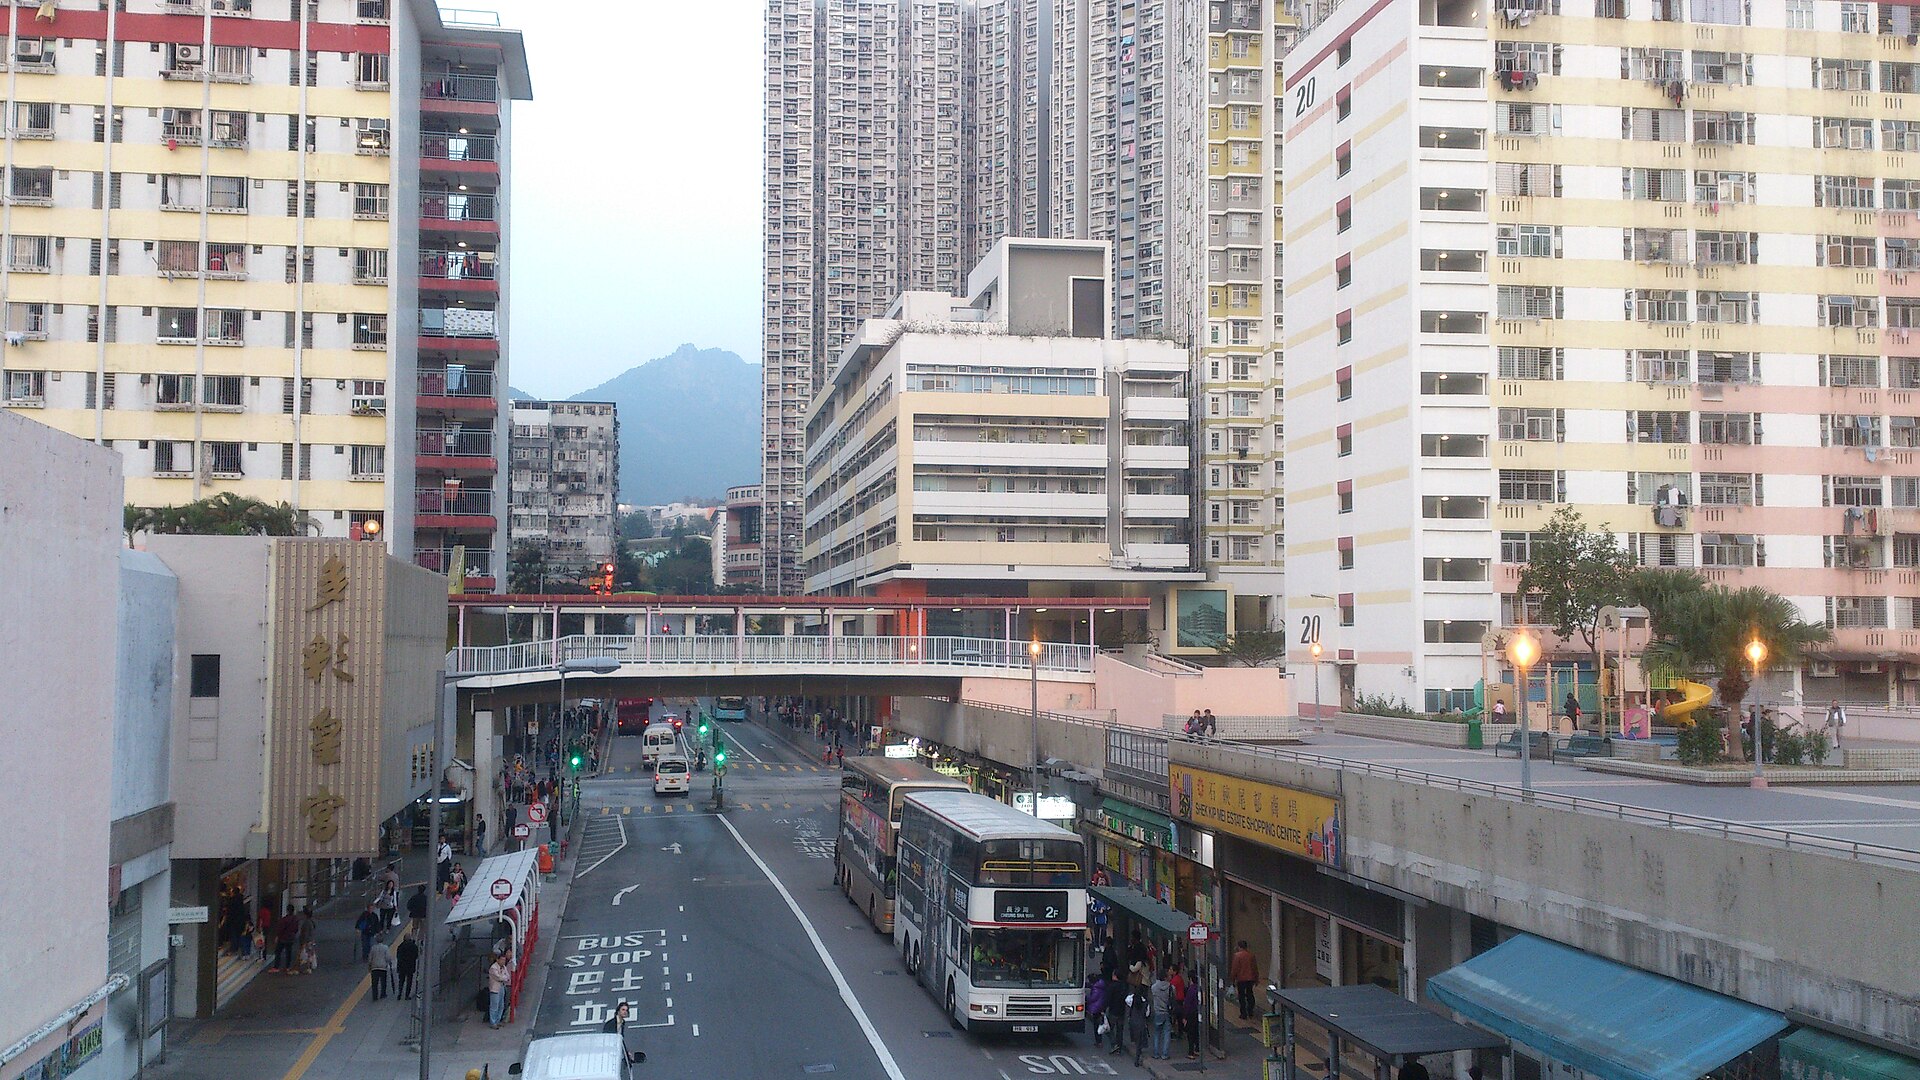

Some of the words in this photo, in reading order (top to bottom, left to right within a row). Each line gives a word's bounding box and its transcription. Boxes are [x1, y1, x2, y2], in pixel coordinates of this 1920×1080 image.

[1296, 77, 1315, 117] 20
[1301, 615, 1320, 643] 20
[300, 553, 354, 843] 多彩皇宮
[1195, 802, 1208, 817] SHEK
[1227, 811, 1246, 829] ESTATE
[1246, 816, 1276, 837] SHOPPING
[1276, 824, 1301, 844] CENTRE
[1045, 906, 1059, 918] 2F
[578, 935, 644, 950] BUS
[564, 950, 651, 968] STOP
[566, 968, 643, 995] 巴士
